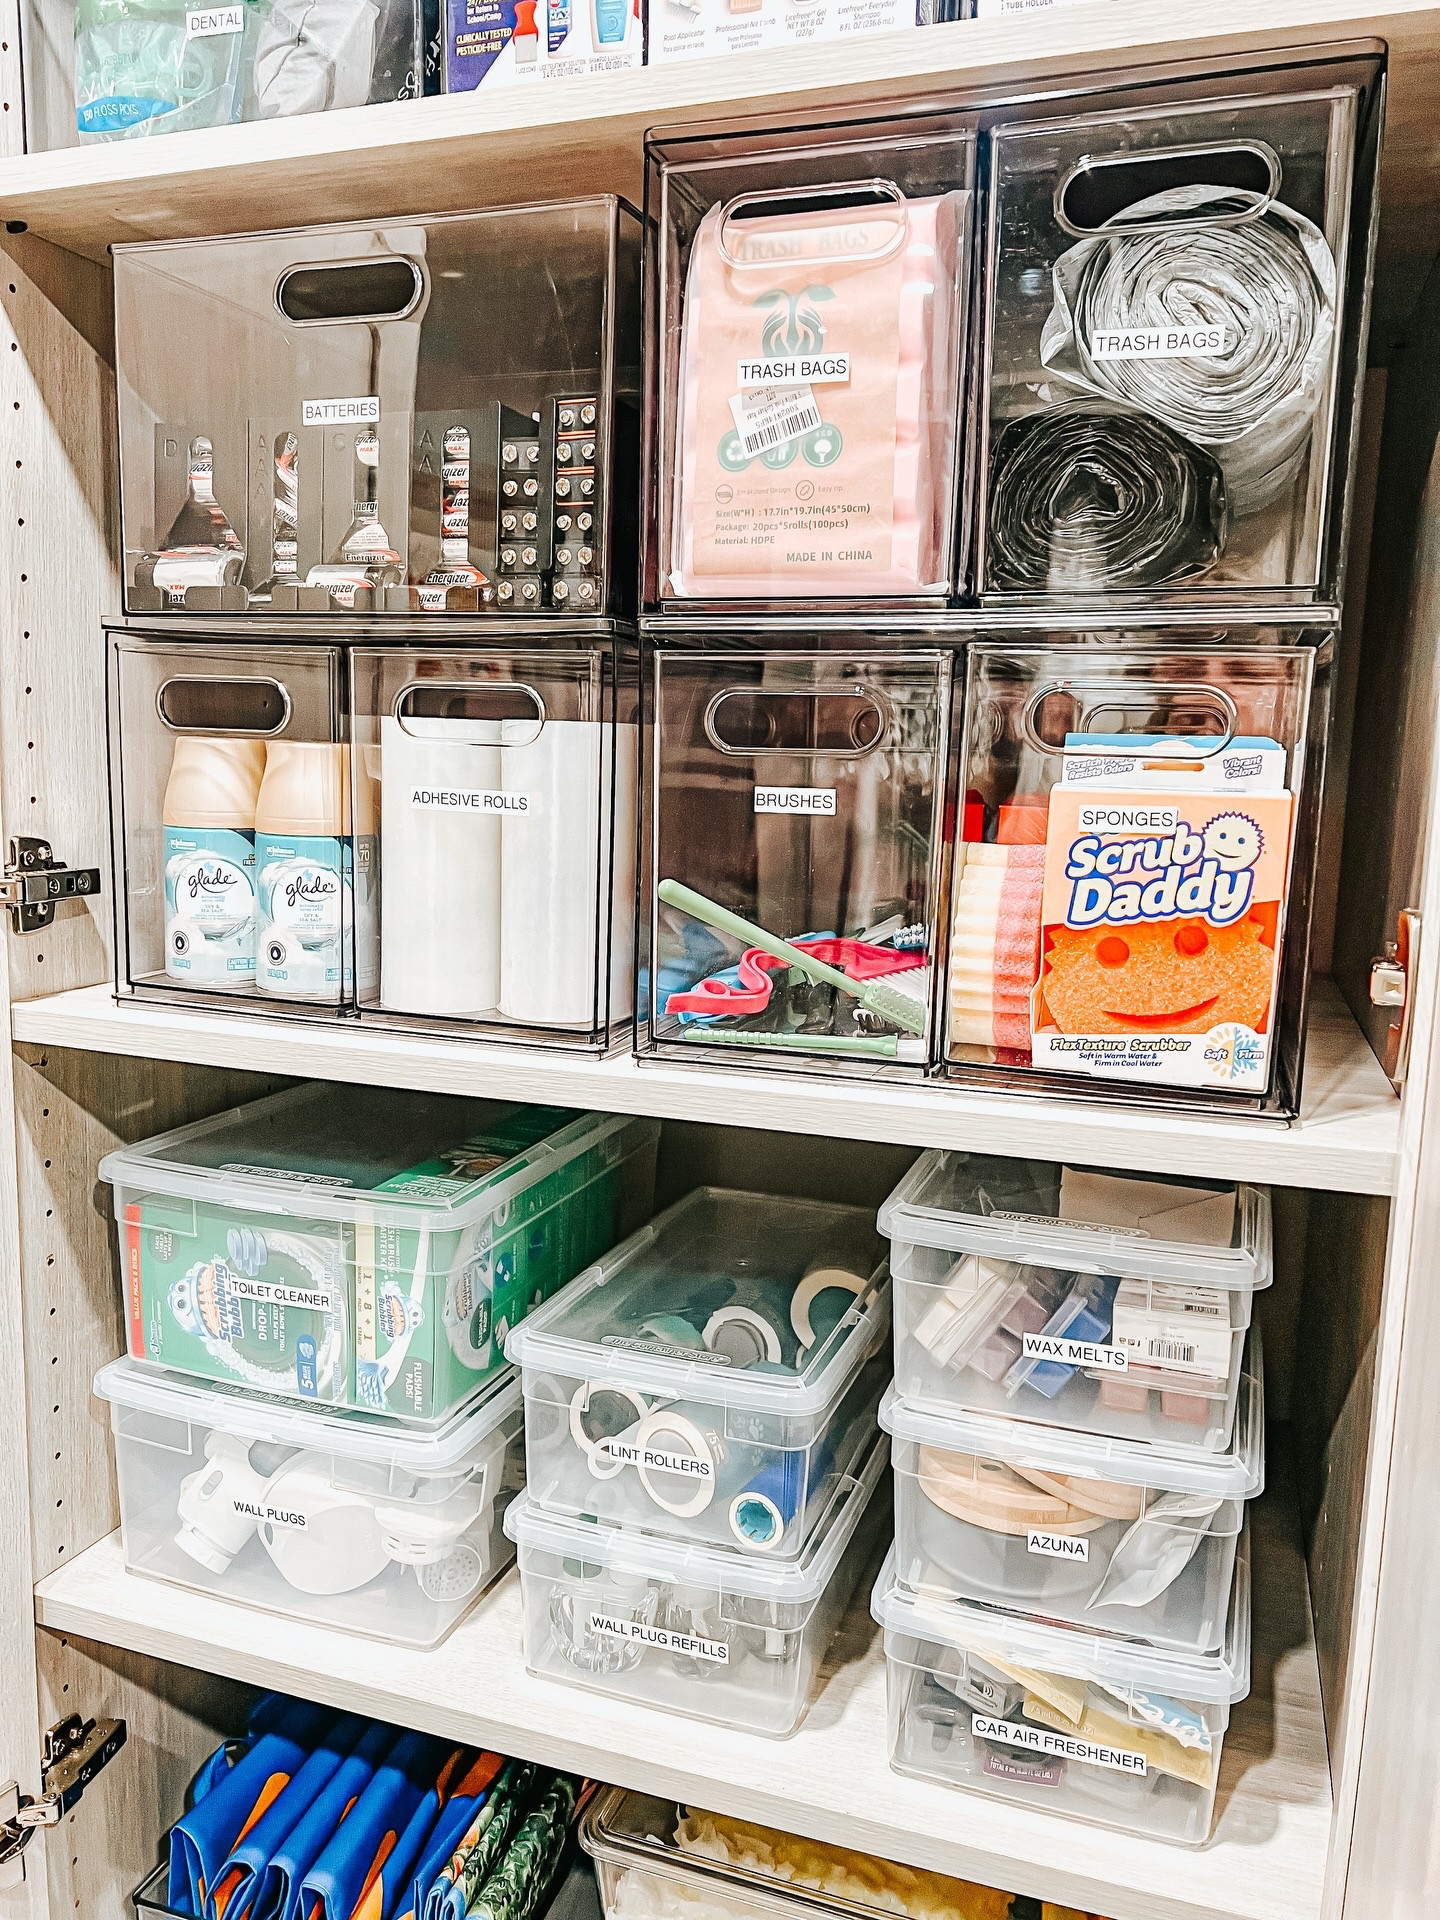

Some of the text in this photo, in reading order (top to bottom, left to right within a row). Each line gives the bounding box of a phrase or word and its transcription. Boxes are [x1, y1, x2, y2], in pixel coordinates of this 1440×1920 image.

[816, 8, 827, 16] Gel
[868, 0, 896, 11] Everyday
[1006, 1, 1025, 10] TUBE
[190, 12, 241, 31] DENTAL
[715, 22, 749, 33] Professional
[786, 17, 825, 30] NET WT OZ
[844, 22, 852, 31] FL
[853, 21, 863, 30] OZ
[882, 18, 895, 27] mL)
[456, 27, 512, 45] CLINICALLY TESTED
[663, 29, 705, 42] Root Applicator
[795, 28, 815, 38] (227g)
[456, 41, 502, 57] PESTICIDE-FREE
[93, 104, 119, 118] FLOSS
[119, 103, 139, 116] PICKS
[1096, 331, 1220, 352] TRASH BAGS
[740, 359, 847, 380] TRASH BAGS
[305, 402, 377, 419] BATTERIES
[715, 524, 750, 533] Package:
[714, 536, 775, 545] Material: HDPE
[345, 553, 386, 562] Energizer
[786, 550, 873, 563] MADE IN CHINA
[426, 572, 470, 585] Energizer
[1066, 758, 1102, 772] Scratch
[1222, 755, 1263, 769] Vibrant
[1067, 764, 1134, 780] Resists Odors
[1224, 765, 1262, 779] Colors!
[412, 790, 528, 811] ADHESIVE ROLLS
[756, 793, 833, 809] BRUSHES
[1081, 810, 1174, 828] SPONGES
[1066, 821, 1205, 879] Scrub
[188, 867, 238, 898] glade
[285, 876, 337, 907] glade
[1067, 858, 1255, 925] Daddy
[1050, 1038, 1191, 1052] FlexTexture Scrubber
[1078, 1052, 1095, 1060] Soft
[1095, 1052, 1103, 1060] in
[1103, 1052, 1127, 1060] Warm
[1128, 1052, 1151, 1060] Water
[1203, 1049, 1229, 1060] Soft
[1237, 1049, 1265, 1060] Firm
[1139, 1060, 1163, 1068] Water
[363, 1273, 372, 1281] 1
[131, 1276, 140, 1297] PACK
[231, 1281, 271, 1298] TOILET
[274, 1287, 329, 1307] CLEANER
[131, 1297, 140, 1320] VALUE
[212, 1263, 231, 1342] Scrubbing
[363, 1302, 372, 1310] 8
[377, 1297, 387, 1333] Bubbles
[384, 1294, 395, 1339] Scrubbing
[610, 1338, 630, 1347] The
[686, 1352, 719, 1363] Store
[1025, 1338, 1064, 1357] WAX
[1068, 1345, 1126, 1366] MELTS
[301, 1379, 313, 1390] 5
[405, 1372, 413, 1399] PADS!
[413, 1361, 423, 1412] FLUSHABLE
[611, 1444, 640, 1461] LINT
[644, 1452, 710, 1475] ROLLERS
[233, 1500, 306, 1526] WALL PLUGS
[1030, 1535, 1085, 1556] AZUNA
[592, 1616, 727, 1659] WALL PLUG REFILLS
[975, 1718, 1008, 1739] CAR
[1012, 1729, 1039, 1746] AIR
[1043, 1735, 1145, 1771] FRESHENER
